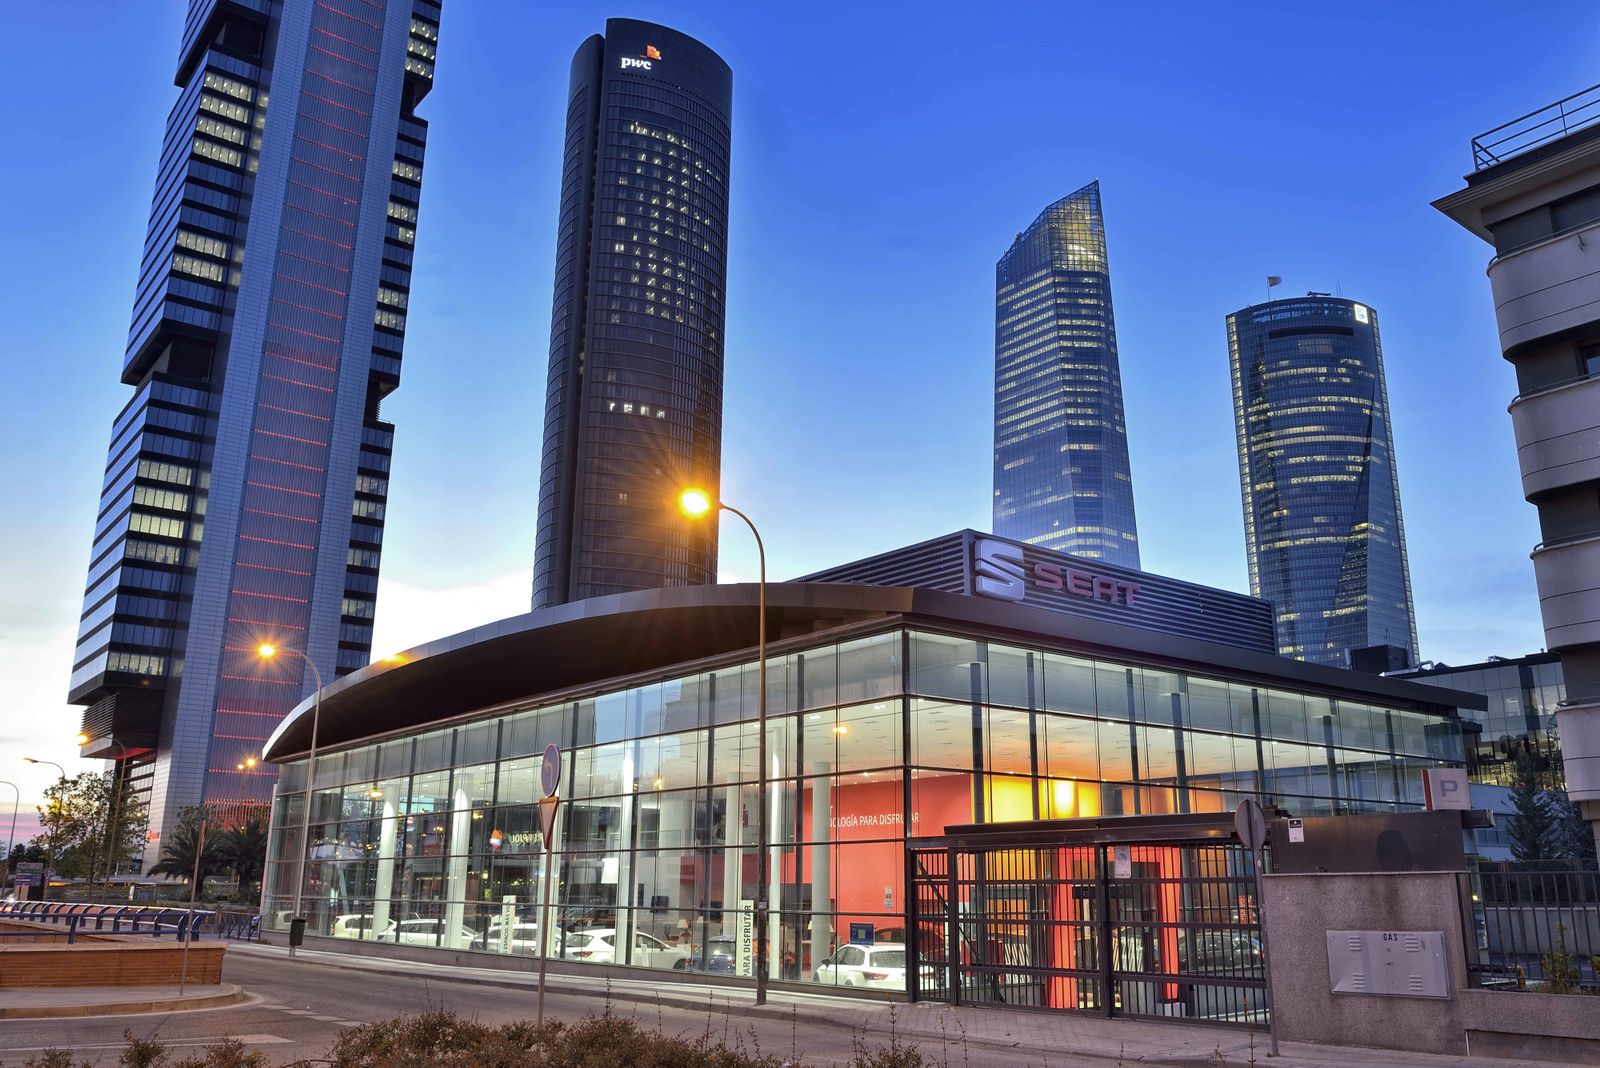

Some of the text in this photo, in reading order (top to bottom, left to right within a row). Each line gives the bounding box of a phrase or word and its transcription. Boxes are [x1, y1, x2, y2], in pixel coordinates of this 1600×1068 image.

[621, 57, 652, 70] pwc
[1033, 562, 1142, 607] SEAT
[1440, 780, 1458, 797] P
[859, 815, 878, 826] PARA
[743, 905, 752, 953] DISFRUTAR
[1383, 933, 1398, 941] GAS
